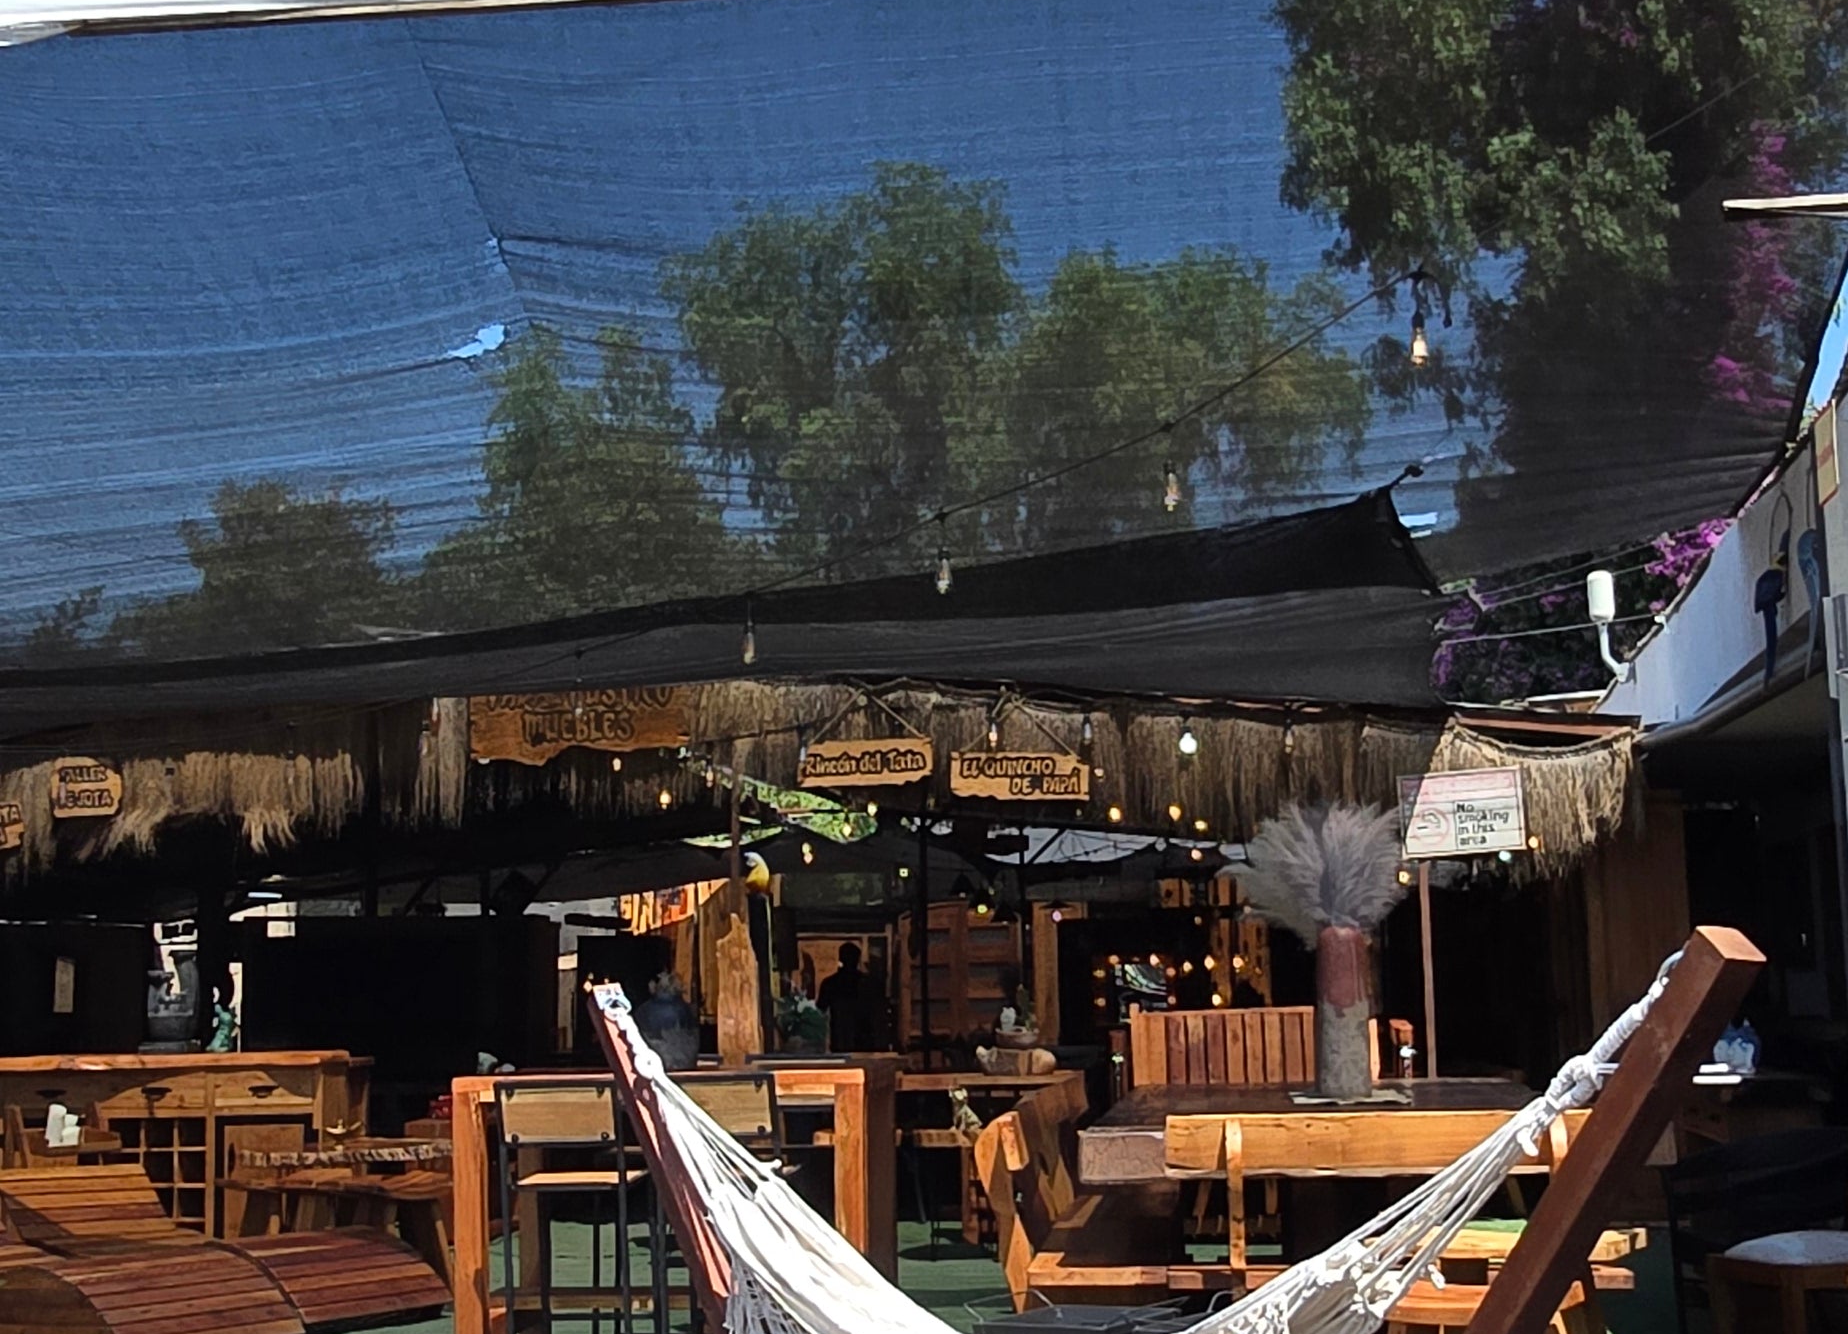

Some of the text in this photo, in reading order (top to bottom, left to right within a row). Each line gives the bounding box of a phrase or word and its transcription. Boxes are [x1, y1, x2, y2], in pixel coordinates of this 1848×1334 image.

[524, 709, 634, 743] MUEBLES
[860, 752, 882, 773] del
[887, 749, 926, 771] Tata
[961, 757, 1055, 778] EL QUINCHO
[1010, 776, 1033, 795] DE
[1456, 803, 1475, 813] No
